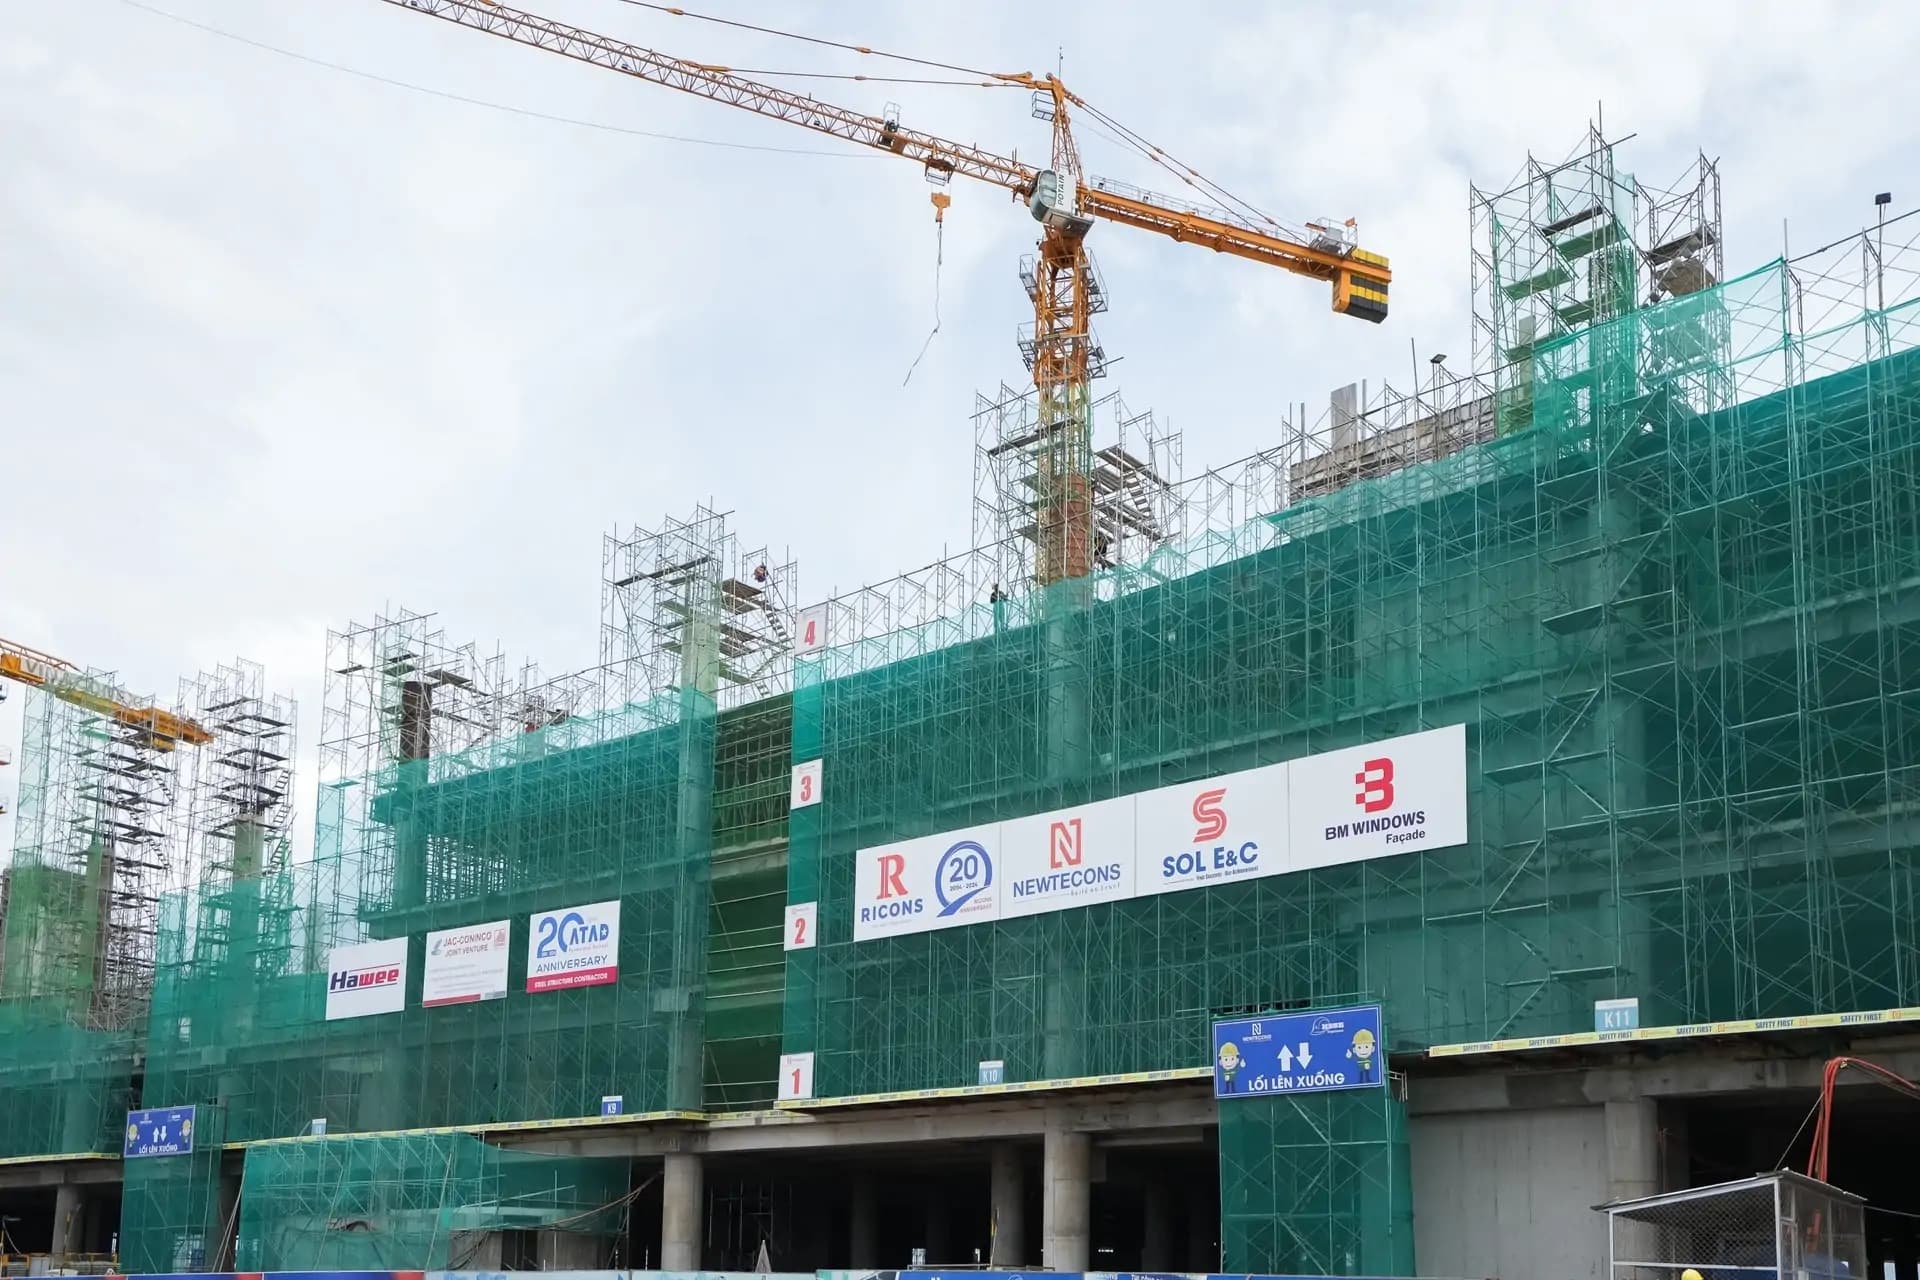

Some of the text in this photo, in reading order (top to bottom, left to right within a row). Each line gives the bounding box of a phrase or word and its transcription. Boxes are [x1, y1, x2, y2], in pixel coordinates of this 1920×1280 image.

[804, 620, 815, 646] 4
[800, 775, 812, 802] 3
[1325, 810, 1426, 841] BM WINDOWS
[1385, 829, 1426, 845] Façade
[1050, 818, 1082, 869] N
[949, 854, 979, 883] 20
[1163, 851, 1207, 878] SOL
[1214, 841, 1259, 870] E&C
[876, 854, 909, 900] R
[1013, 863, 1121, 898] NEWTECONS
[861, 898, 924, 922] RICONS
[536, 912, 585, 959] 20
[569, 923, 609, 946] ATAD
[794, 917, 806, 944] 2
[536, 954, 608, 973] ANNIVERSARY
[330, 968, 400, 990] Hawee
[1604, 1010, 1630, 1028] K11
[792, 1068, 801, 1094] 1
[1248, 1069, 1345, 1091] LỐI LÊN XUỐNG
